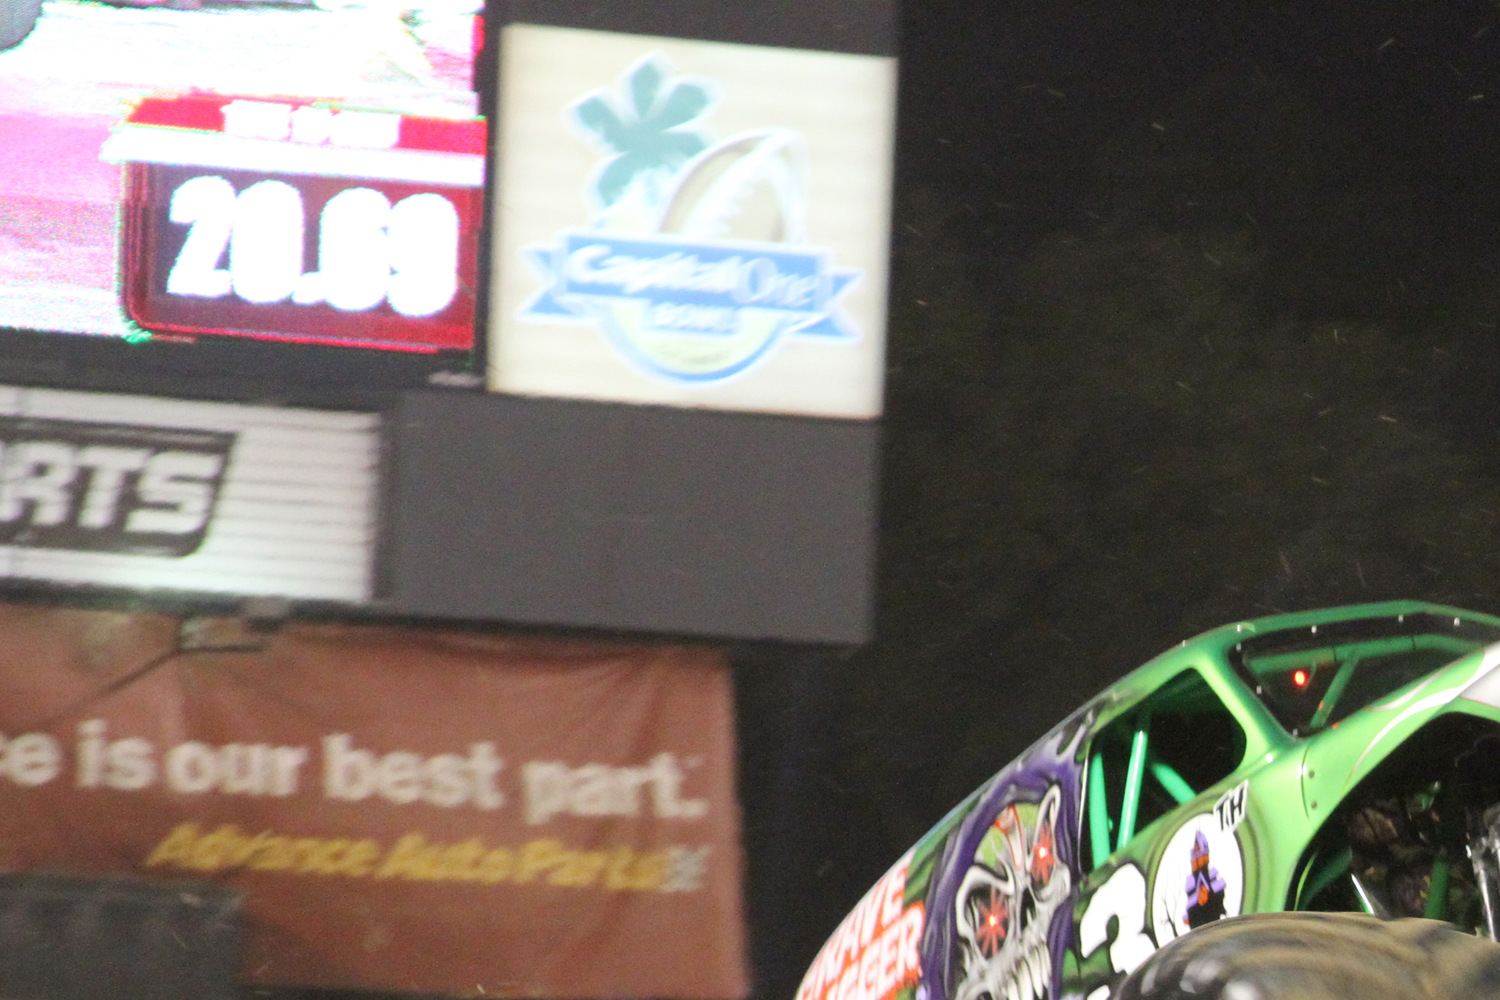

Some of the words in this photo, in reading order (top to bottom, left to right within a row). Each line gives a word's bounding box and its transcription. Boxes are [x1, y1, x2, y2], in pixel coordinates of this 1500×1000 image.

[0, 440, 223, 534] RTS
[0, 732, 63, 786] e
[76, 719, 157, 790] is
[165, 741, 308, 798] our
[322, 732, 506, 812] best
[522, 753, 708, 826] part.
